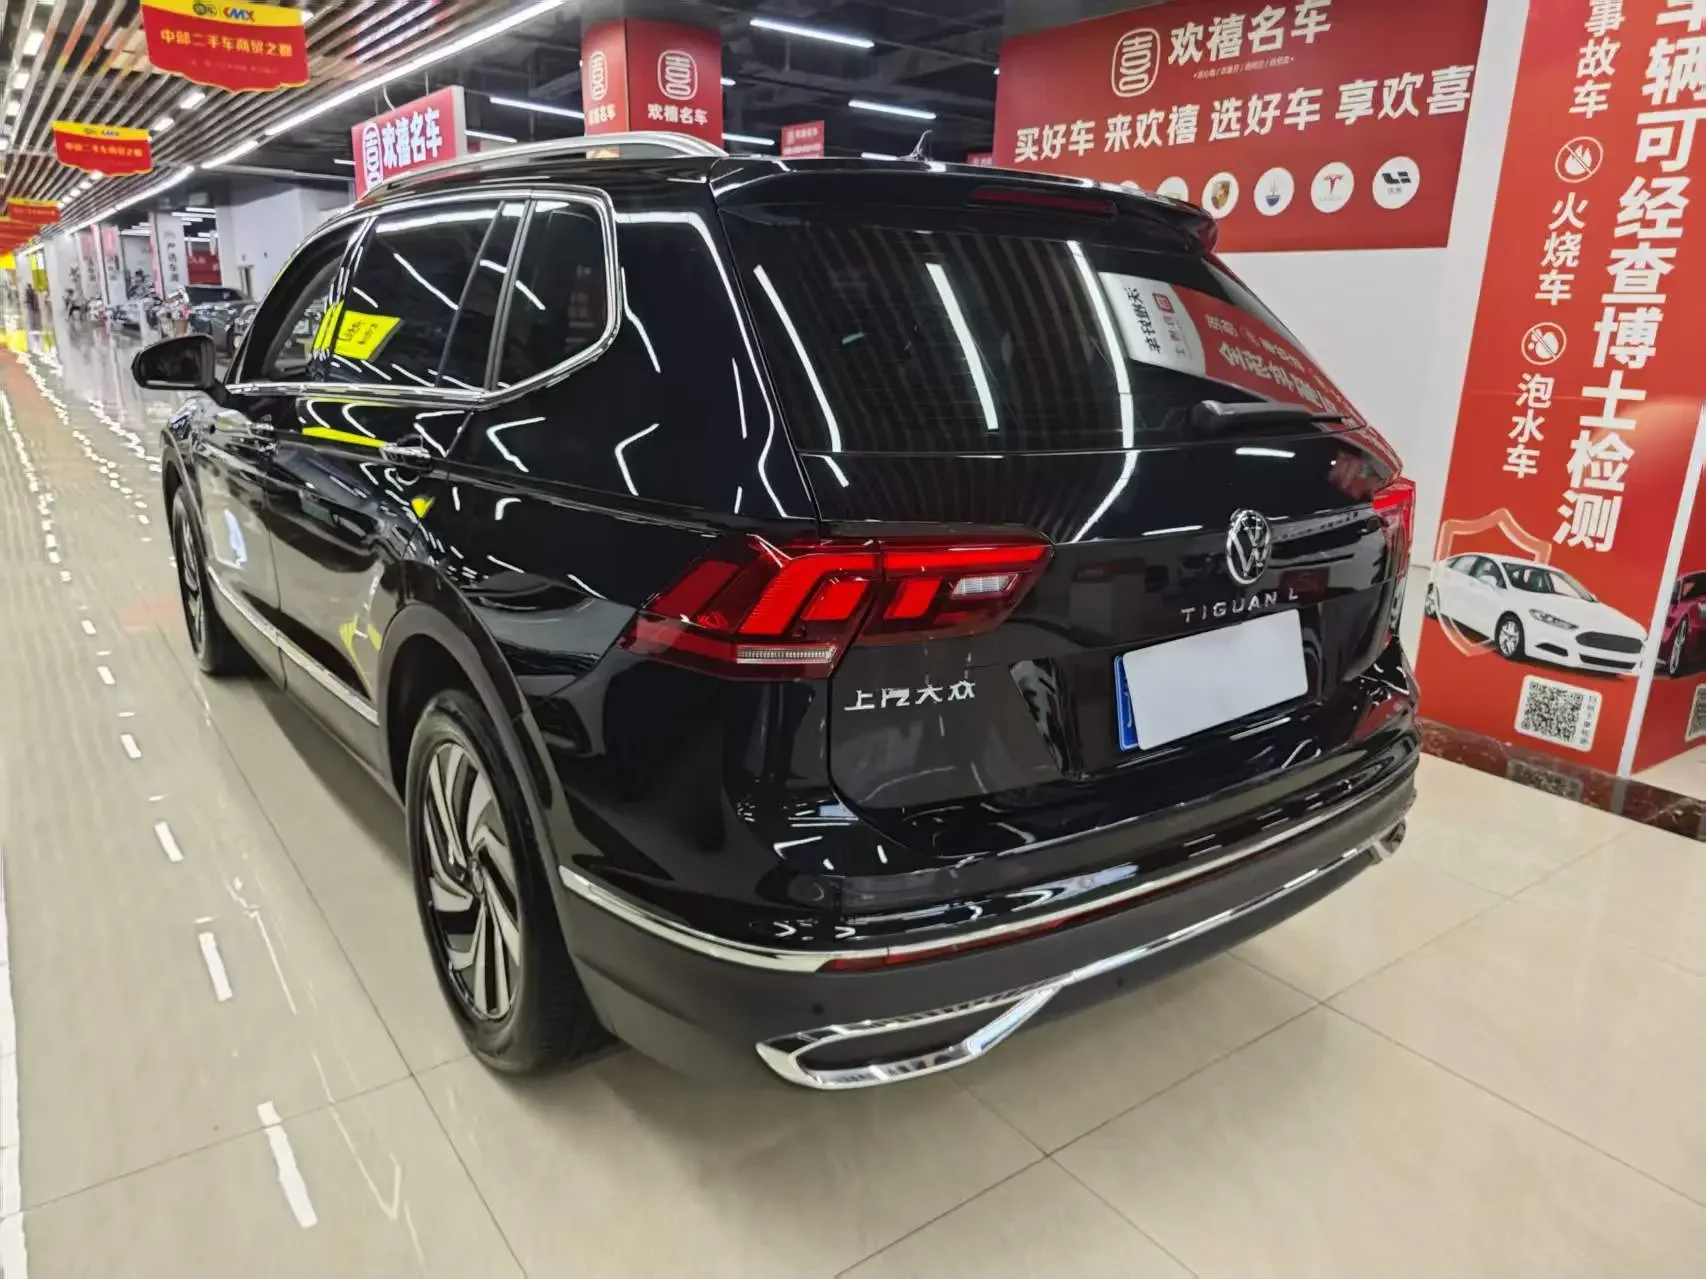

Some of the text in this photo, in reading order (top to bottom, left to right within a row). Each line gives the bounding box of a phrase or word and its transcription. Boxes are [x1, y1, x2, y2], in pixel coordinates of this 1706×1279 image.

[1168, 0, 1332, 66] 欢禧名车
[1568, 0, 1625, 119] 事故车
[382, 106, 443, 169] 欢禧名车
[1014, 120, 1096, 163] 买好车
[1104, 104, 1200, 153] 来欢禧
[1208, 86, 1323, 142] 选好车
[1335, 64, 1475, 126] 享欢喜
[1535, 192, 1588, 306] 火烧车
[1502, 373, 1554, 478] 泡水车
[1181, 587, 1299, 623] TIGUAN L
[844, 680, 976, 711] 上汽大众
